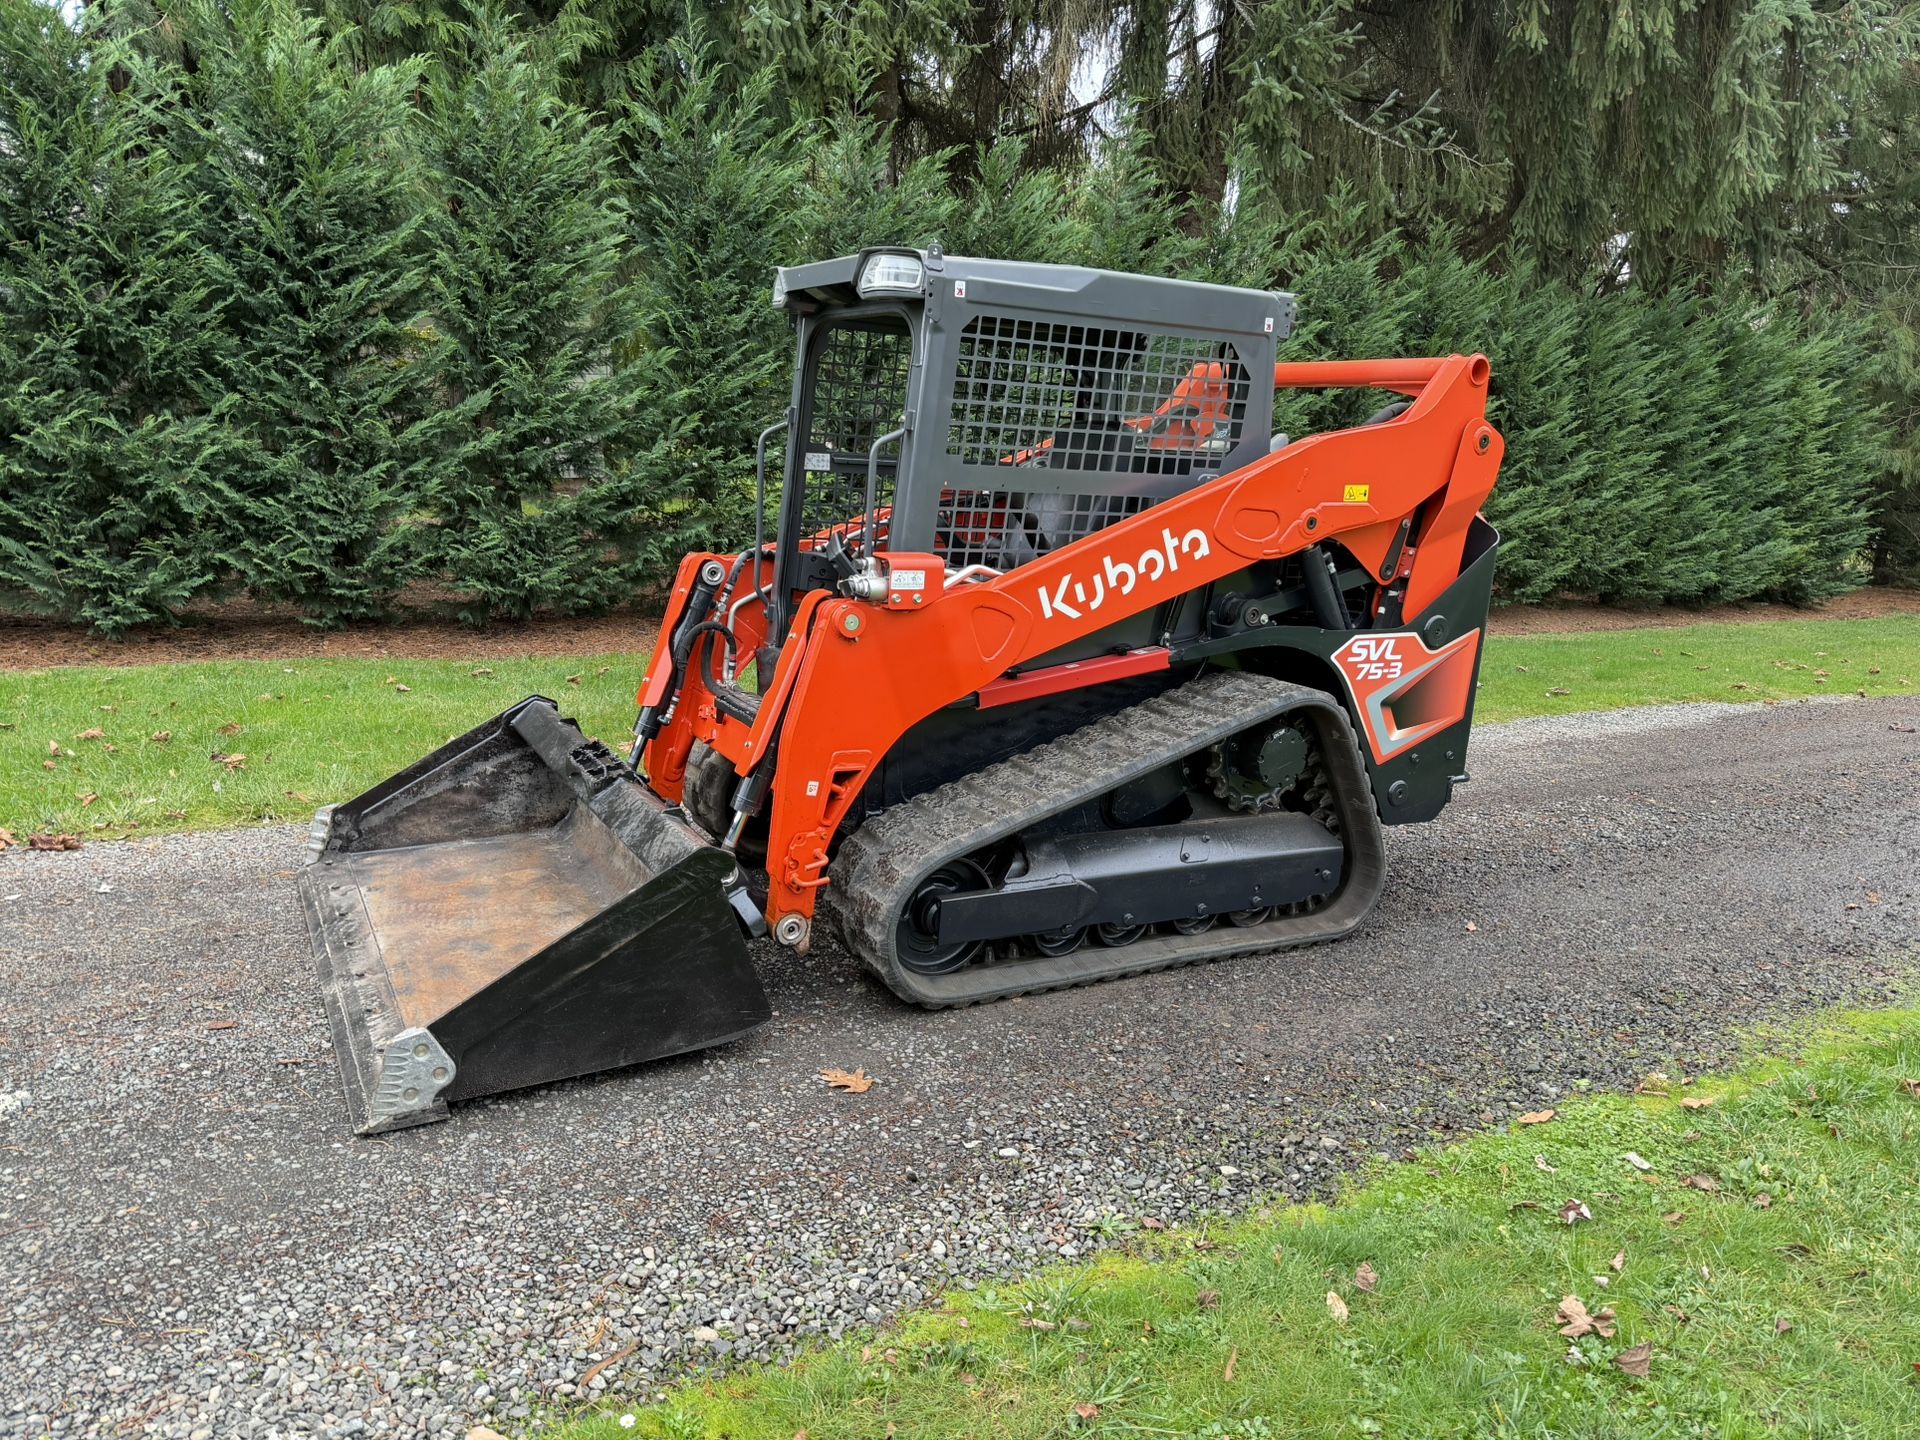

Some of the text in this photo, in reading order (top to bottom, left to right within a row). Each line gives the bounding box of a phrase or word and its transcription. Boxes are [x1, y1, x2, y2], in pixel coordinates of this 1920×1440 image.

[1037, 527, 1211, 620] Kubota
[1347, 639, 1403, 662] SVL
[1355, 661, 1403, 681] 75-3
